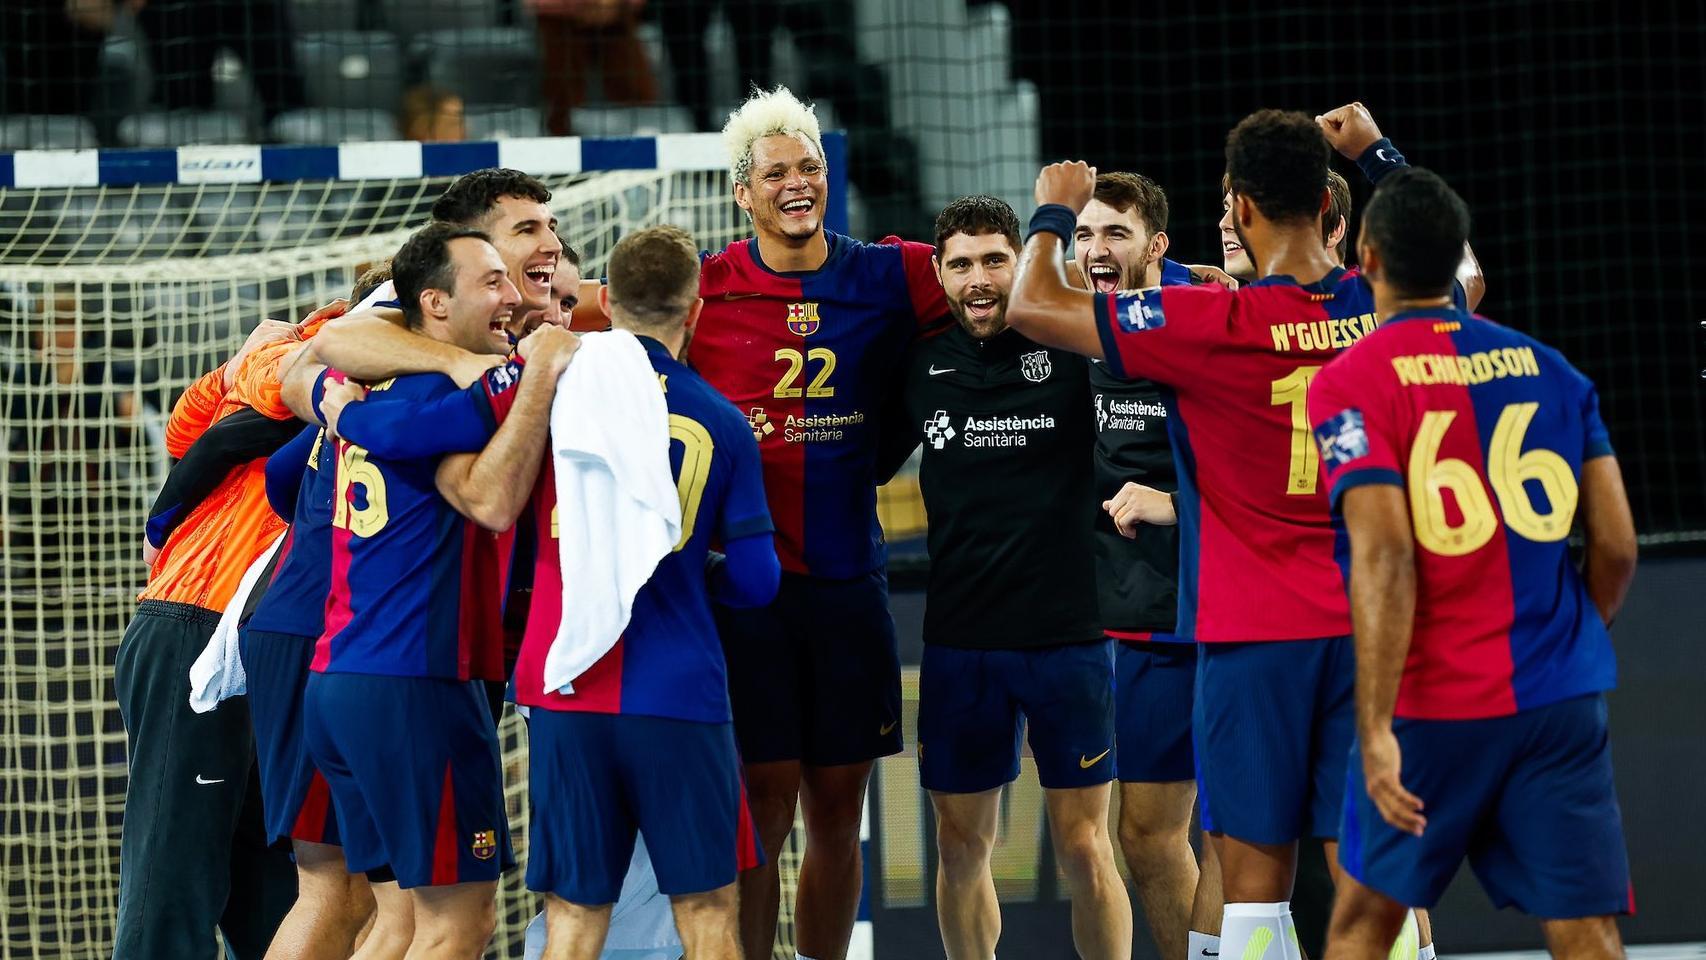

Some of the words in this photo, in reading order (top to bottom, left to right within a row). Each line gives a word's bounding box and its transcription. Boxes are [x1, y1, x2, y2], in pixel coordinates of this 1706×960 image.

[1270, 312, 1379, 351] N'GUESSA
[773, 347, 837, 398] 22
[1391, 347, 1540, 386] RICHARDSON
[1109, 399, 1167, 418] Assistència
[784, 411, 864, 428] Assistència
[963, 414, 1055, 431] Assistència
[1107, 414, 1146, 431] Sanitària
[784, 427, 843, 442] Sanitària
[963, 431, 1027, 447] Sanitària
[1408, 402, 1579, 557] 66
